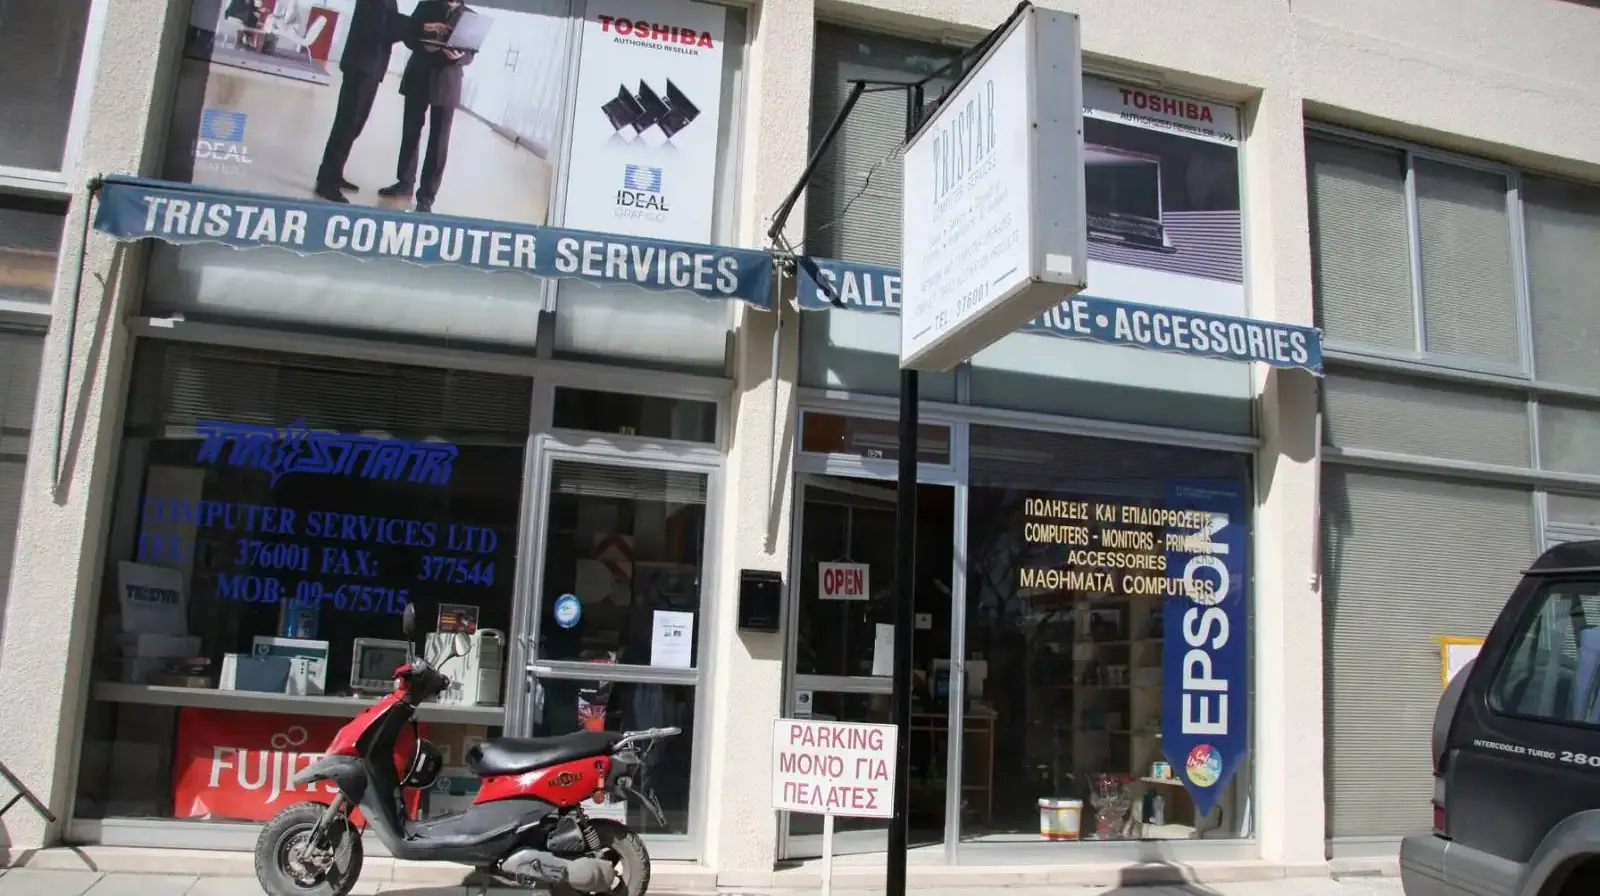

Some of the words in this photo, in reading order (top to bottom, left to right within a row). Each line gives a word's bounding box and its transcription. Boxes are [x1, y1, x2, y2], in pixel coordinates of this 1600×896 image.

[598, 15, 713, 49] TOSHIBA
[613, 37, 662, 50] AUTHORISED
[664, 46, 699, 56] RESELLER
[1119, 88, 1213, 123] TOSHIBA
[933, 79, 996, 205] TRISTAR
[616, 190, 669, 211] IDEAL
[143, 196, 308, 245] TRISTAR
[323, 215, 536, 269] COMPUTER
[555, 237, 739, 294] SERVICES
[956, 280, 990, 318] 376001
[1115, 307, 1308, 364] ACCESSORIES
[1025, 498, 1089, 520] ΠΩΛΗΣΕΙΣ
[1095, 503, 1116, 522] ΚΑΙ
[306, 510, 438, 548] SERVICES
[448, 523, 497, 553] LTD
[1025, 522, 1089, 546] COMPUTERS
[1101, 528, 1154, 551] MONITORS
[233, 538, 311, 571] 376001
[320, 547, 379, 576] FAX:
[417, 555, 496, 588] 377544
[1068, 551, 1167, 571] ACCESSORIES
[216, 572, 286, 604] MOB:
[296, 580, 409, 615] 09-675715
[824, 568, 863, 596] OPEN
[1020, 568, 1115, 592] ΜΑΘΗΜΑΤΑ
[1182, 512, 1229, 734] EPSON
[790, 725, 884, 751] PARKING
[1473, 739, 1525, 754] INTERCOOLER
[1527, 748, 1556, 760] TURBO
[207, 746, 340, 804] FUJIT
[856, 758, 888, 781] ΓΙΑ
[784, 781, 878, 810] ΠΕΛΑΤΕΣ
